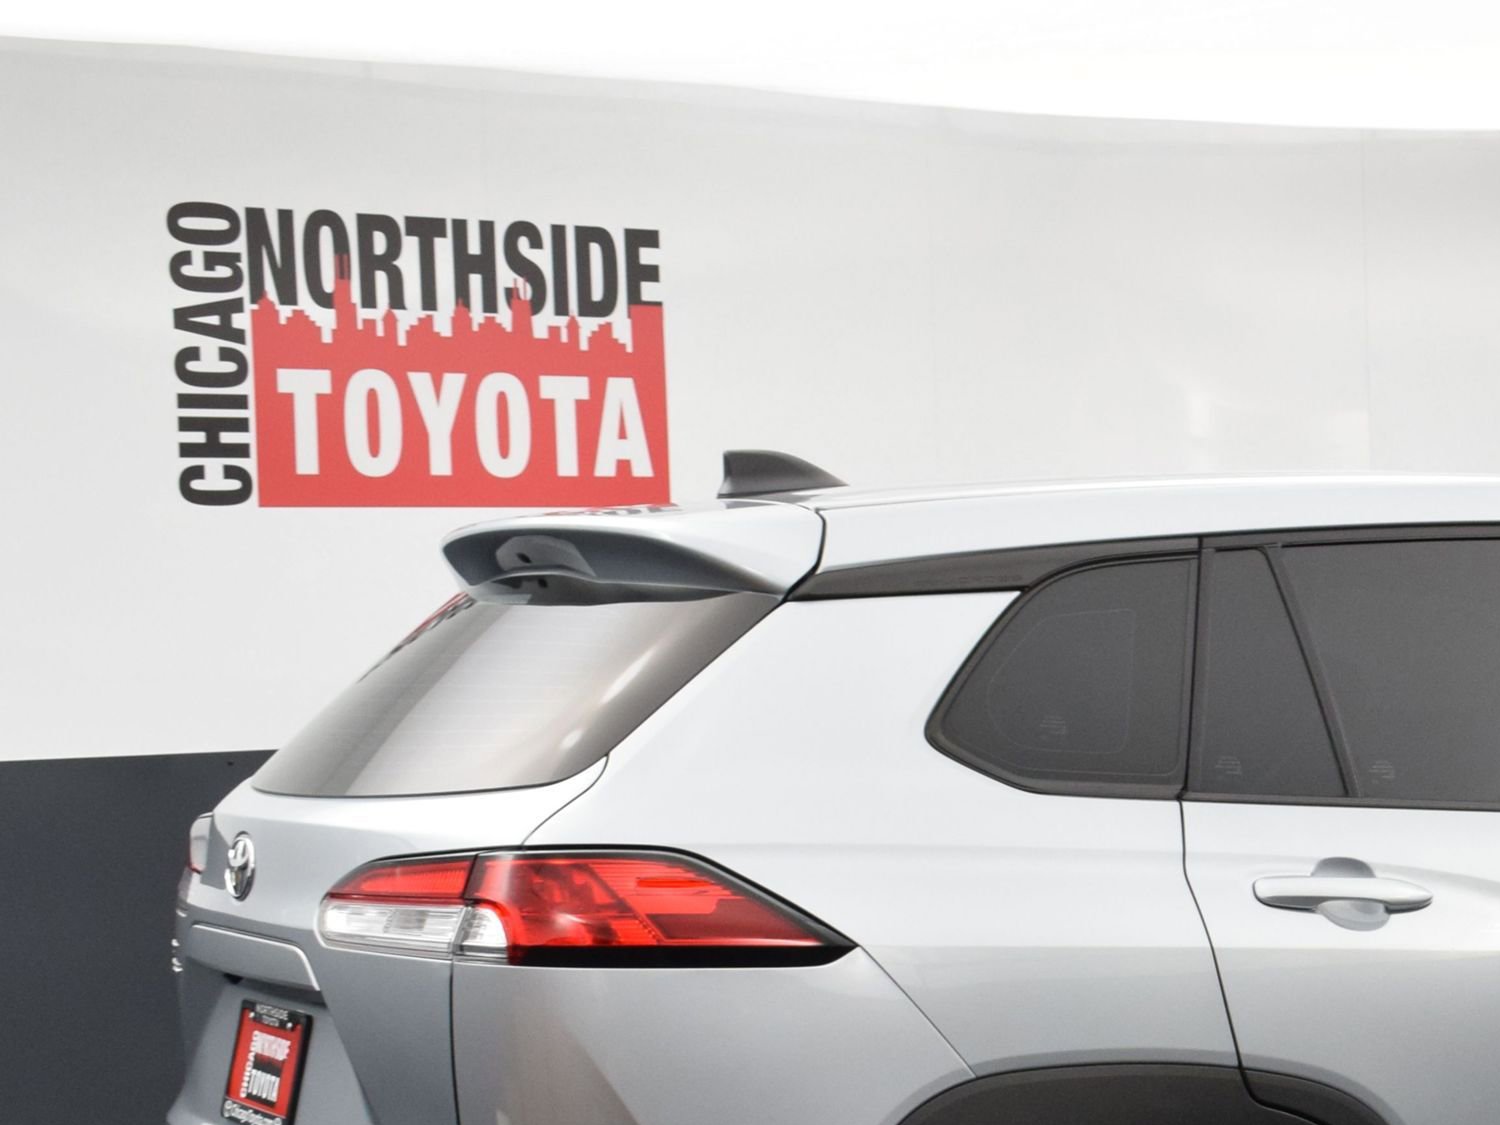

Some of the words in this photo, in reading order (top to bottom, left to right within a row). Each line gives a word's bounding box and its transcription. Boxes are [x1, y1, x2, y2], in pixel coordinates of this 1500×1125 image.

[245, 206, 663, 319] NORTHSIDE
[166, 201, 253, 506] CHICAGO
[276, 368, 655, 479] TOYOTA
